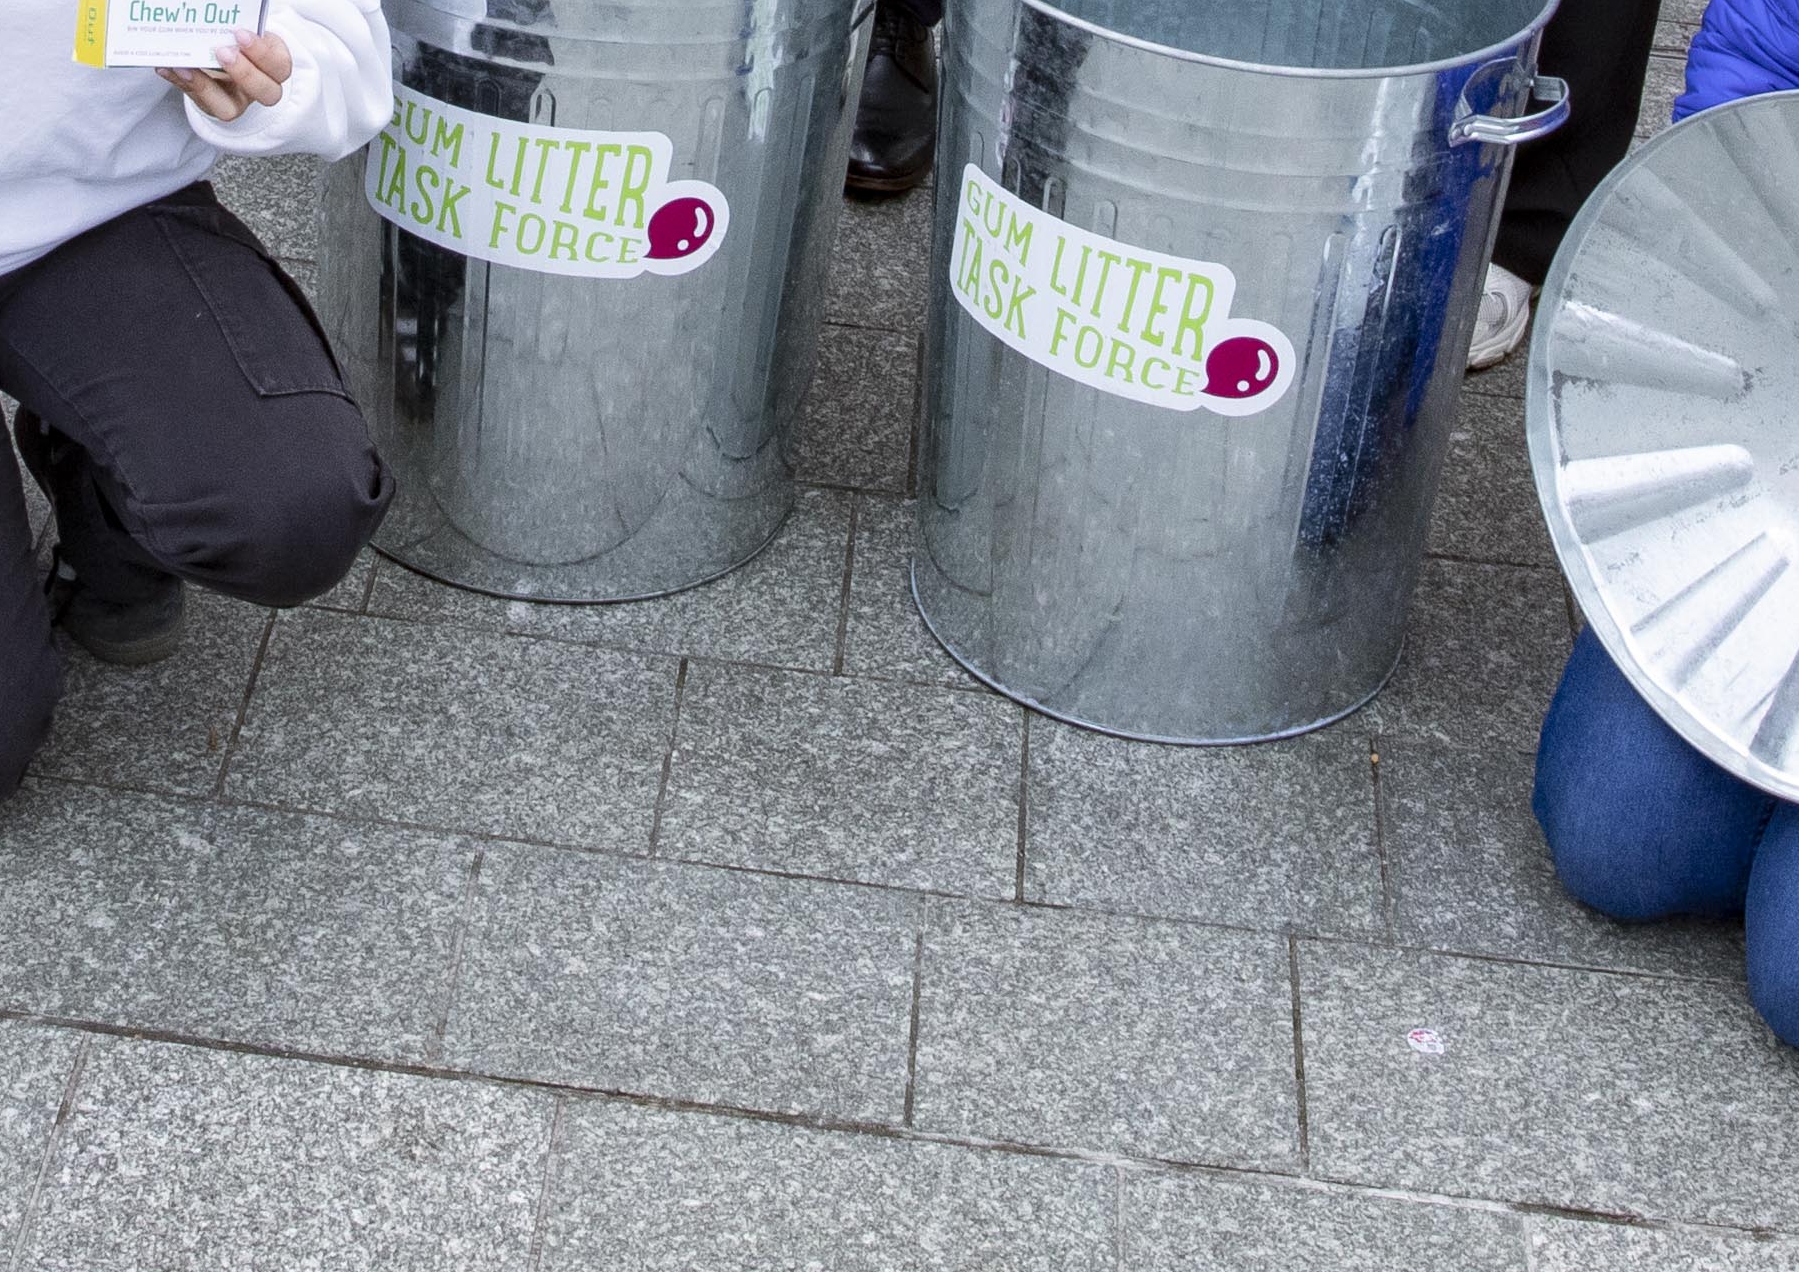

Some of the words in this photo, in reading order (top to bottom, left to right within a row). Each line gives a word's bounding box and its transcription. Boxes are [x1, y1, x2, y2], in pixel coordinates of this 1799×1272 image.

[129, 0, 197, 23] Chew'n
[204, 3, 241, 25] Out
[375, 131, 472, 239] TASK
[489, 200, 643, 264] FORCE
[485, 131, 654, 229] LITTER
[956, 216, 1037, 341] TASK
[1049, 306, 1200, 396] FORCE
[966, 179, 1034, 268] GUM
[1050, 235, 1215, 362] LITTER
